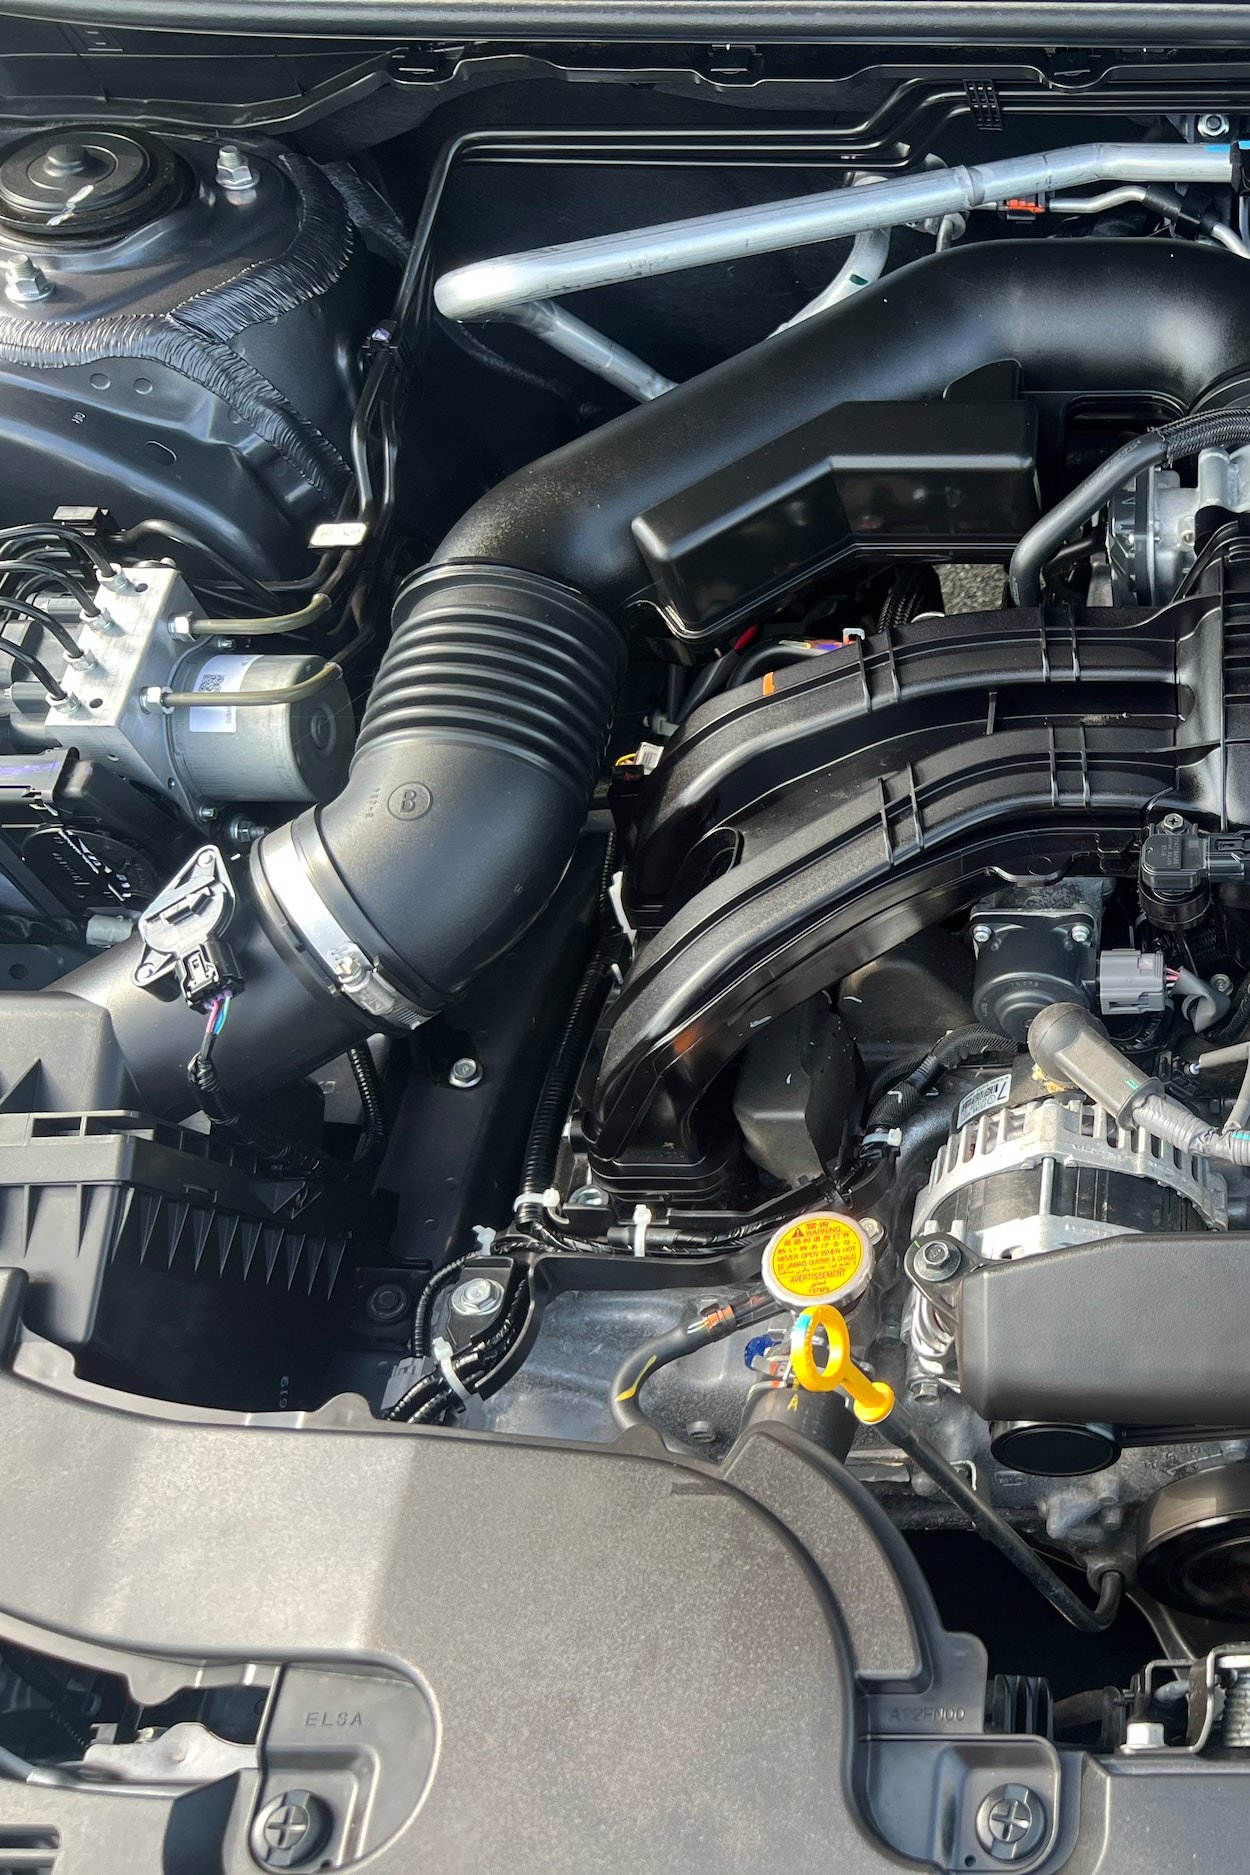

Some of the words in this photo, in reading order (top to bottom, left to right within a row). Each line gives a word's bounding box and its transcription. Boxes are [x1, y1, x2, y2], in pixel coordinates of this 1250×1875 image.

[806, 1226, 841, 1237] WARNING
[778, 1252, 799, 1263] NEVER
[801, 1251, 819, 1259] OPEN
[821, 1248, 841, 1257] WHEN
[790, 1269, 846, 1284] AVERTISSEMENT
[305, 1711, 362, 1728] ELSA
